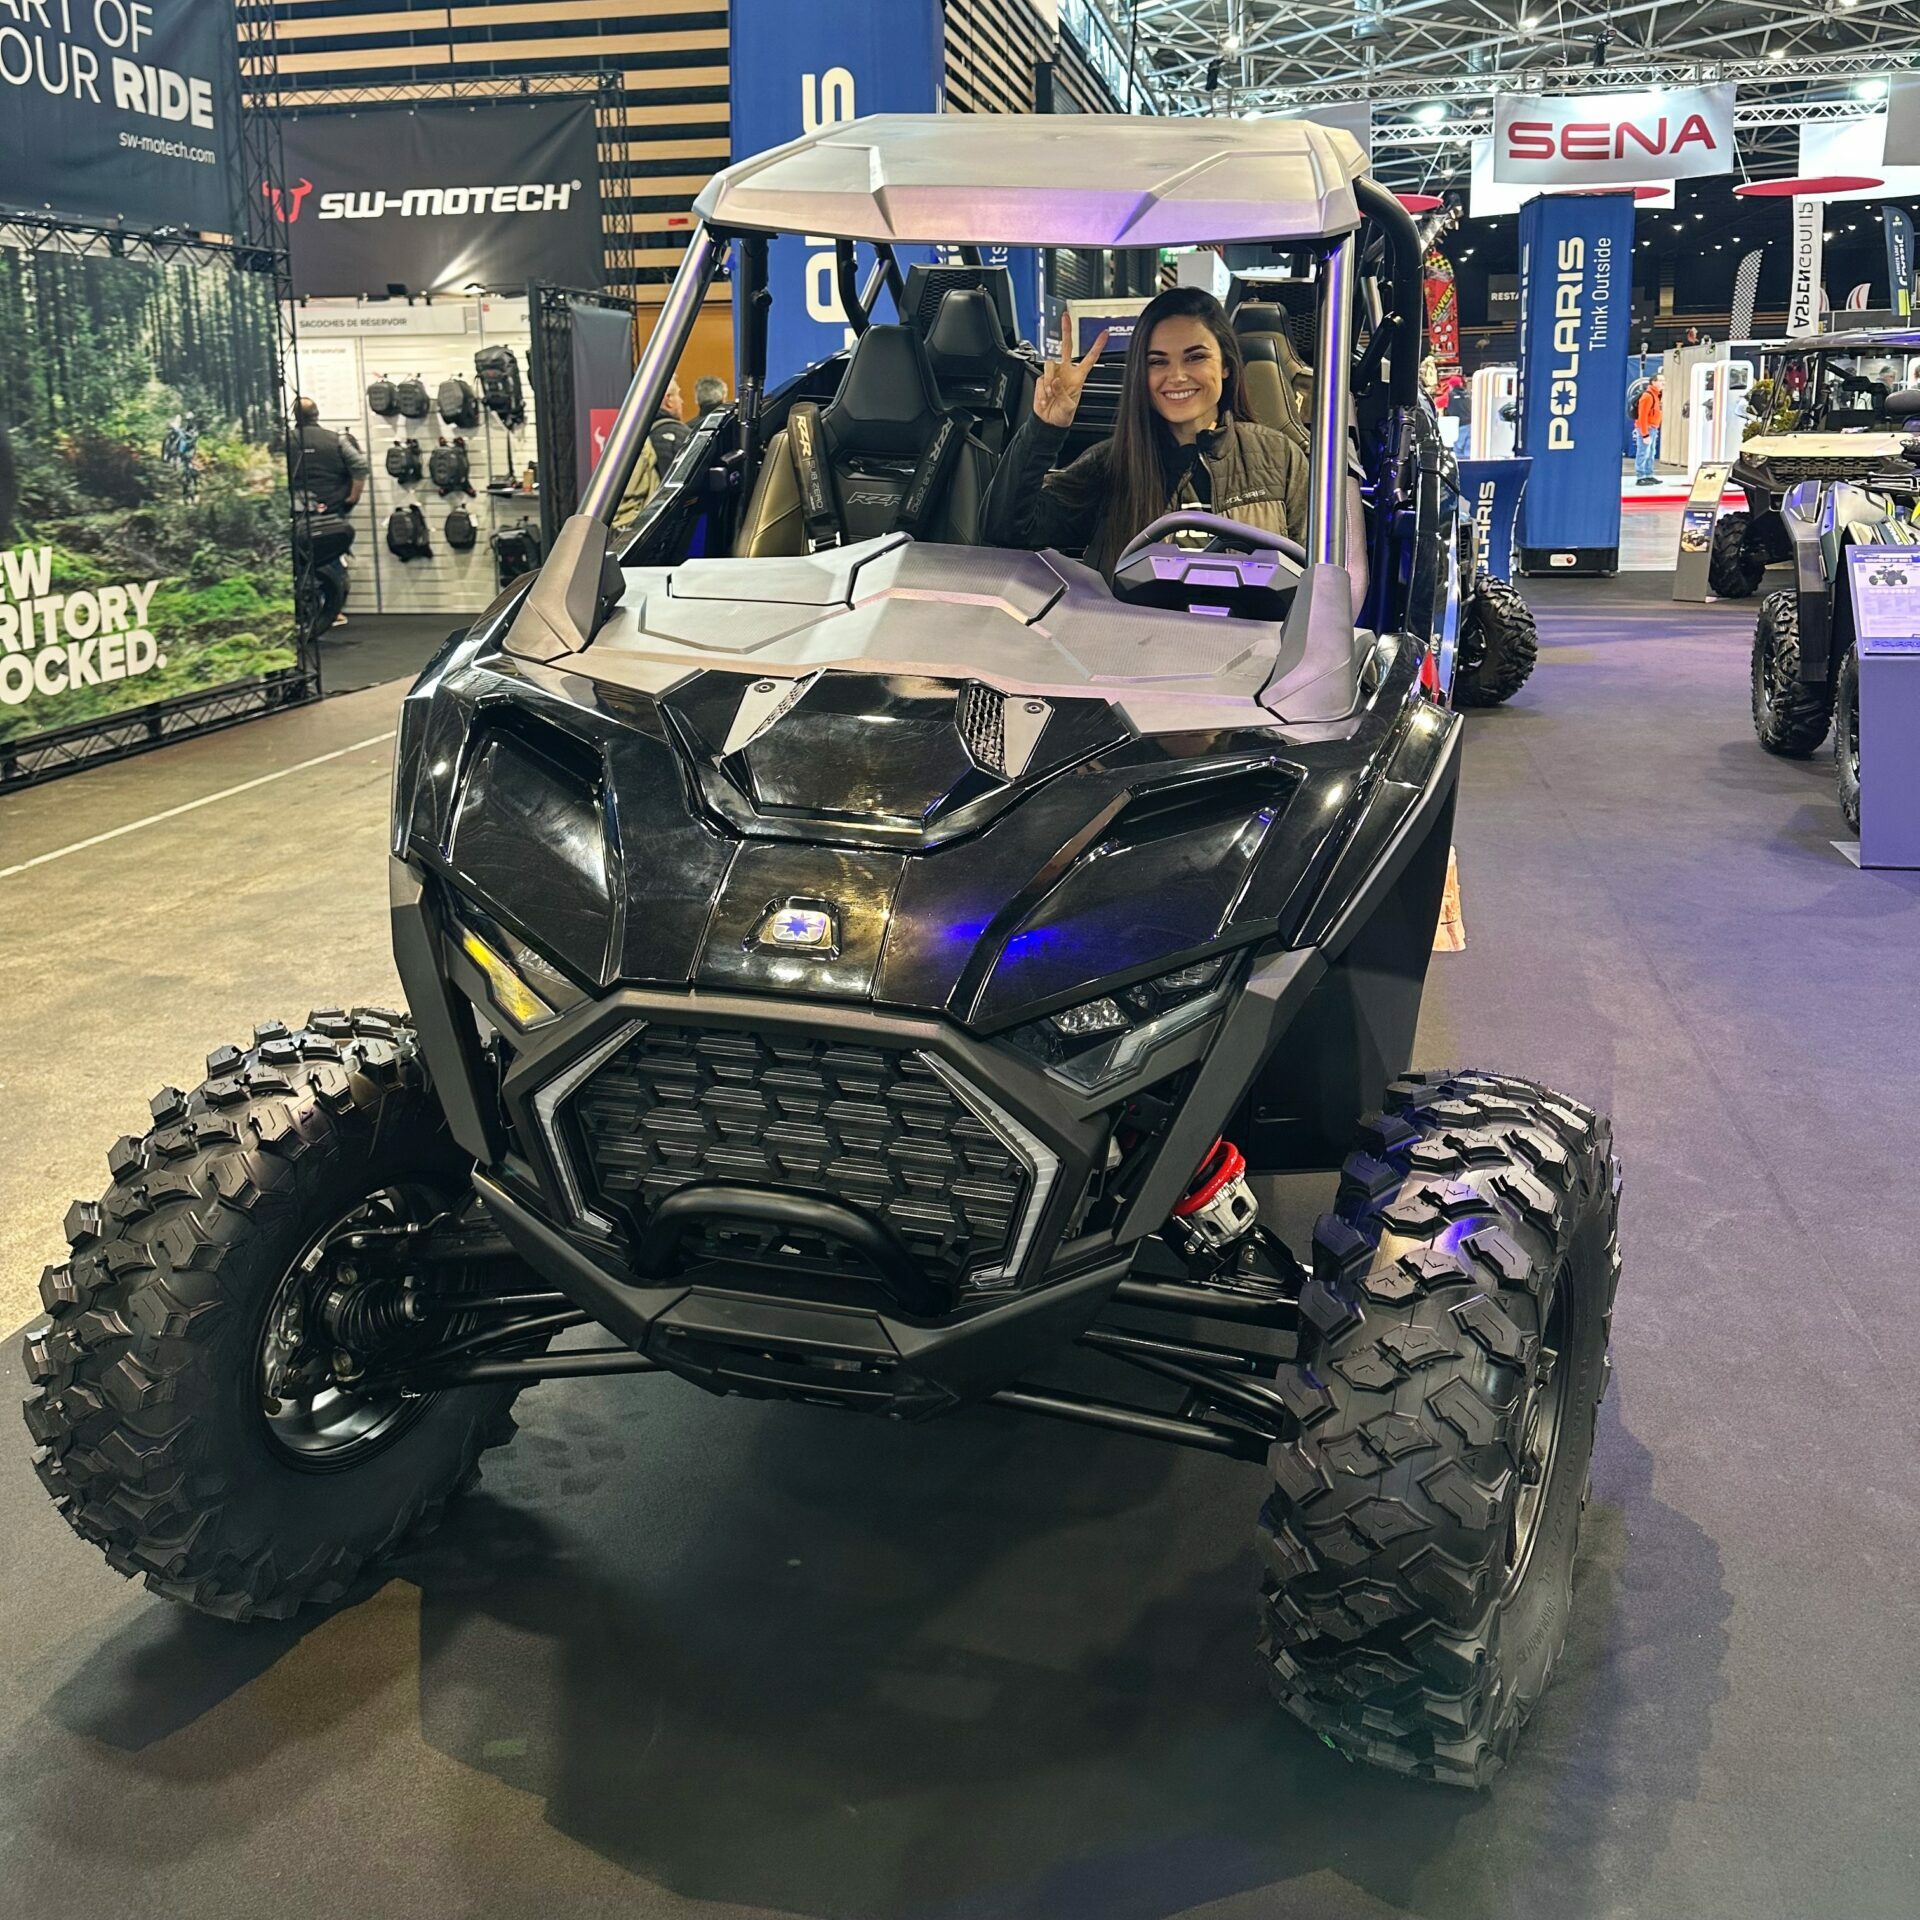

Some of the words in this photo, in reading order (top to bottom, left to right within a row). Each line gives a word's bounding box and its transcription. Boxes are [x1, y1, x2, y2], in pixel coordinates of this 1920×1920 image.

[93, 0, 152, 53] OF
[112, 56, 214, 130] RIDE
[119, 131, 216, 165] sw-motech.com
[1508, 113, 1717, 160] SENA
[1592, 237, 1612, 301] Outside
[1548, 236, 1585, 450] POLARIS
[1589, 304, 1609, 351] Think
[796, 415, 812, 457] RZR
[929, 417, 955, 461] RZR
